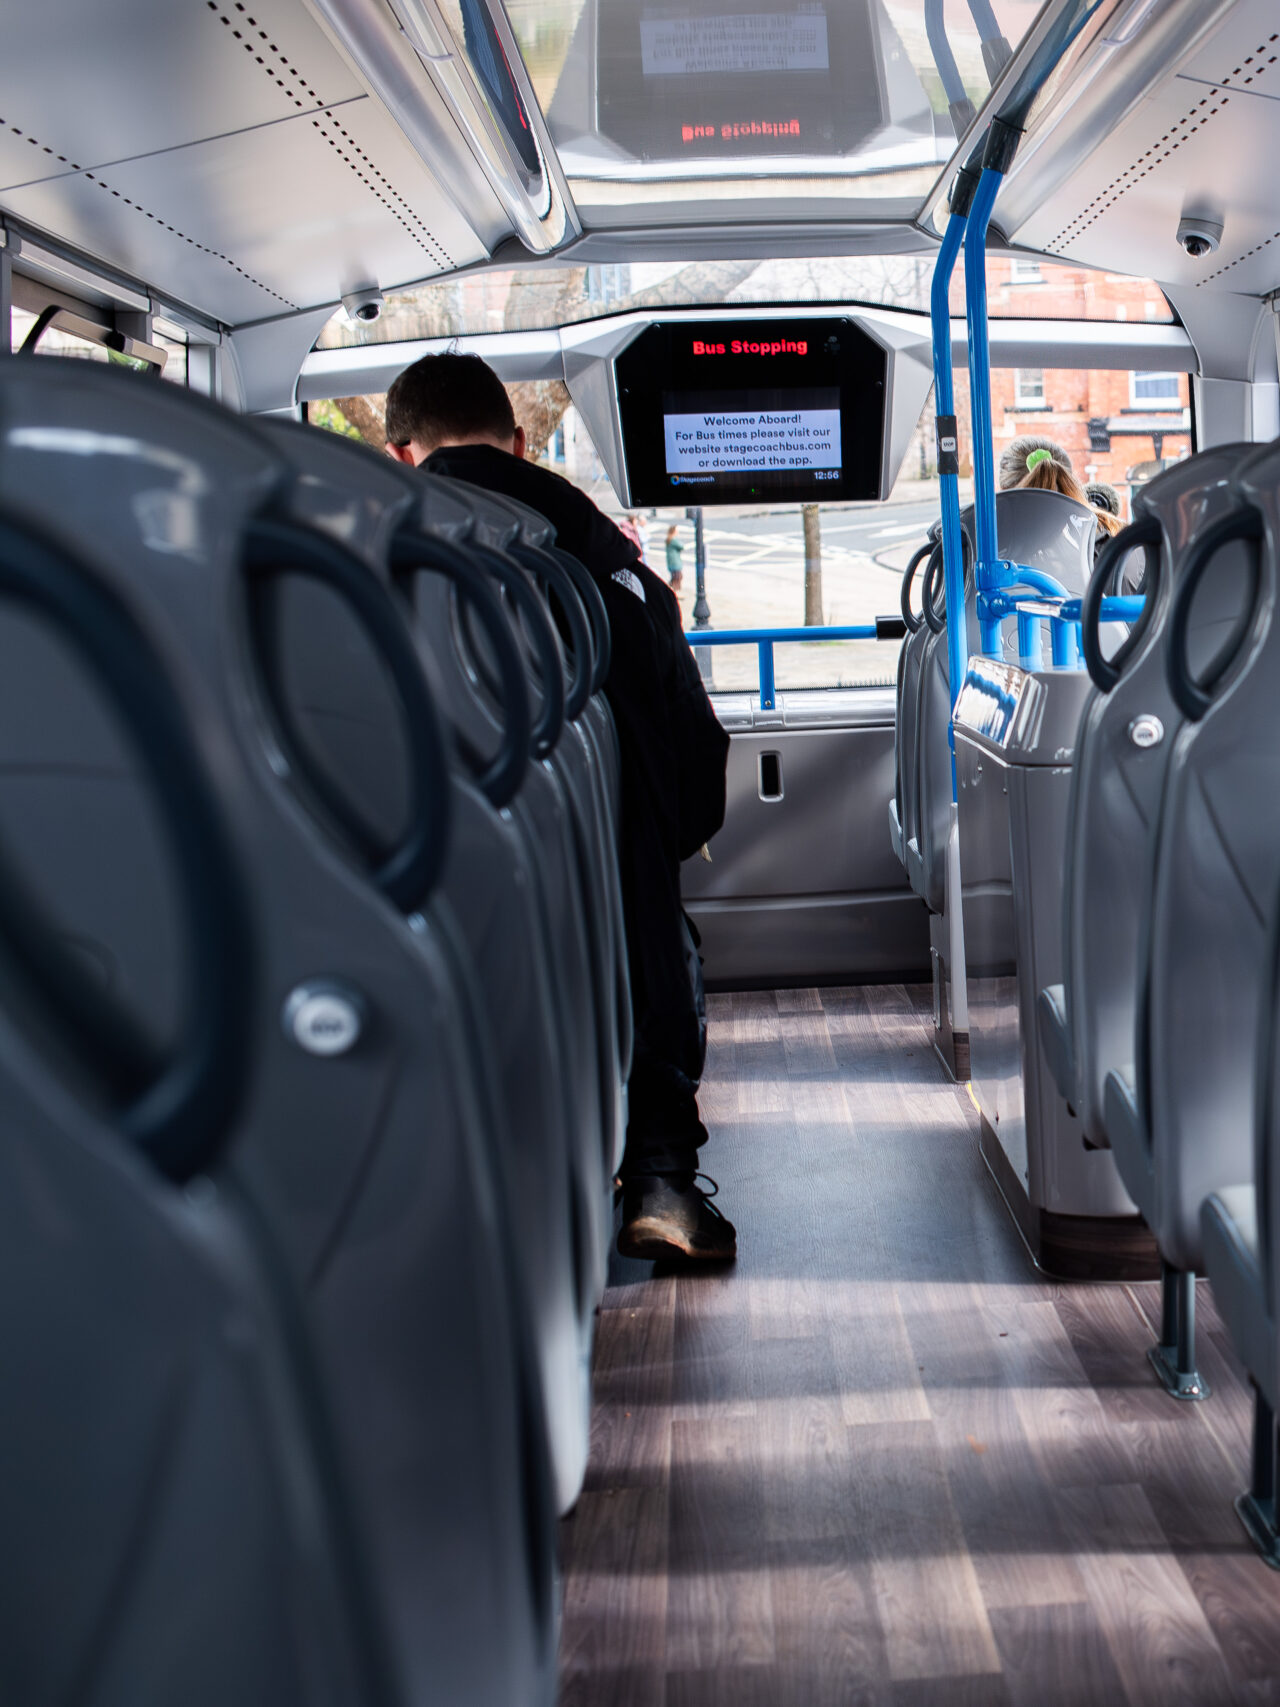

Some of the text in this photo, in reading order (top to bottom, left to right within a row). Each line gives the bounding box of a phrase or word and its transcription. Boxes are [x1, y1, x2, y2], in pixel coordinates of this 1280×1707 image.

[693, 339, 808, 356] Bus Stopping
[703, 414, 802, 426] Welcome Aboard!
[675, 427, 831, 441] For Bus times please visit our
[678, 441, 832, 455] website stagecoachbus.com
[698, 456, 813, 468] or download the app.
[814, 471, 840, 480] 12:56
